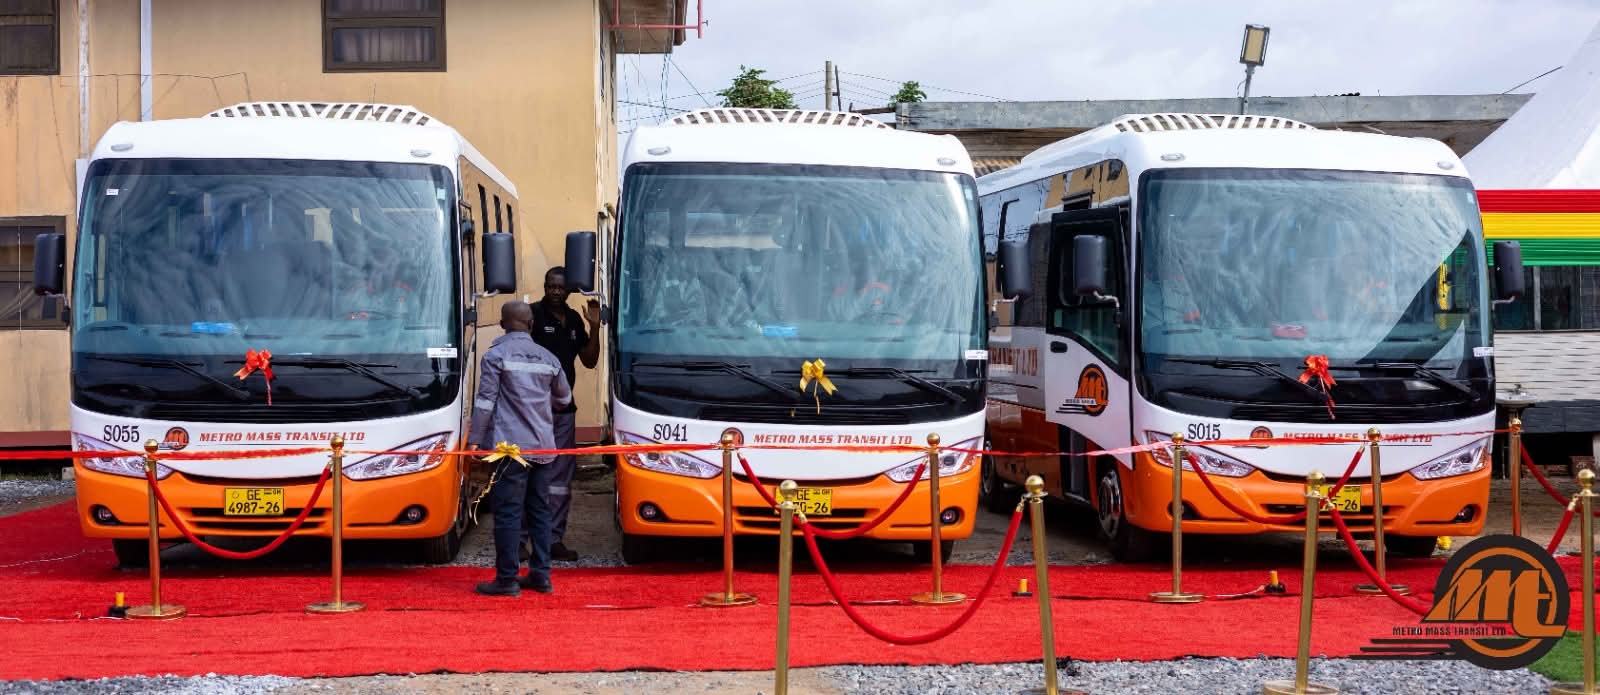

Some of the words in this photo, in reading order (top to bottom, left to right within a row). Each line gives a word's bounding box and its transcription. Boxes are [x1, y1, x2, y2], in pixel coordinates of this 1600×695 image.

[103, 424, 140, 443] S055
[200, 432, 242, 442] METRO
[246, 431, 281, 441] MASS
[342, 431, 366, 441] LTD
[653, 423, 689, 442] S041
[1187, 423, 1222, 441] S015
[753, 434, 796, 444] METRO
[799, 434, 834, 444] MASS
[837, 434, 887, 445] TRANSIT
[890, 435, 913, 445] LTD
[247, 489, 262, 501] GE
[228, 501, 281, 513] 4987-26
